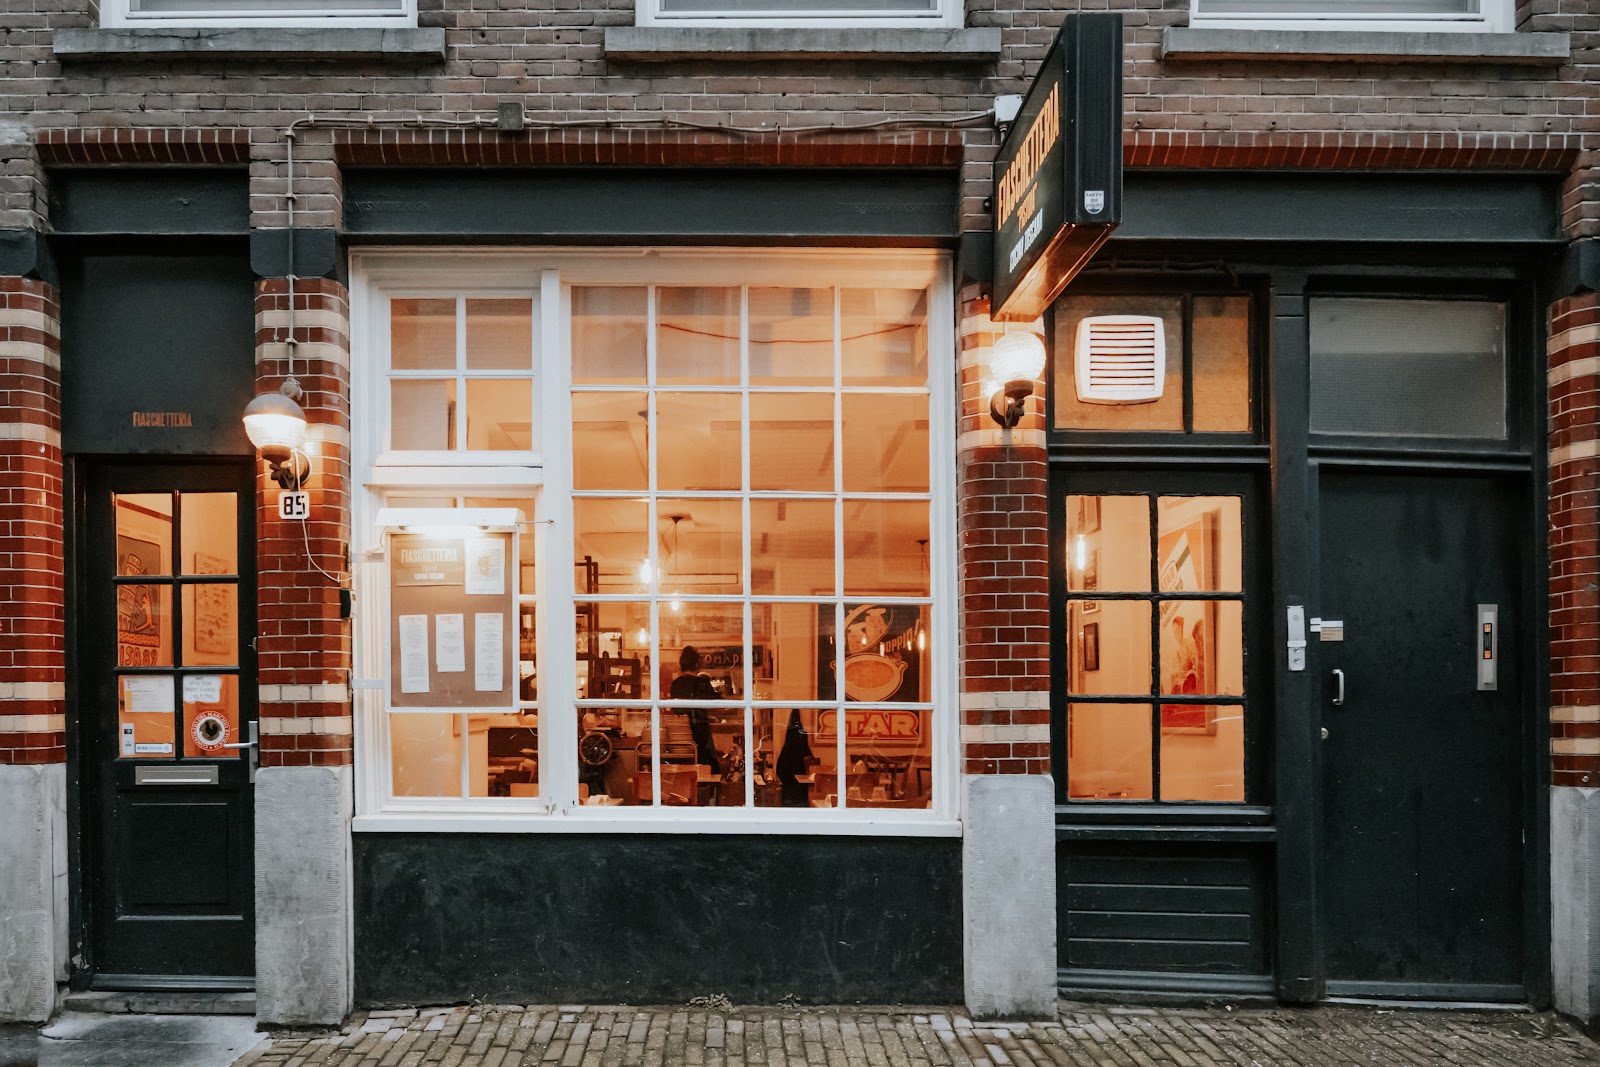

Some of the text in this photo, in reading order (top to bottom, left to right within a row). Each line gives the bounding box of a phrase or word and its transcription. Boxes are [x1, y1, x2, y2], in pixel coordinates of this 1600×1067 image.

[998, 82, 1060, 231] FIASCHETTERIA
[132, 411, 193, 427] FIASCHETTERIA
[401, 548, 458, 563] FIASCHETTERIA
[820, 712, 918, 738] STAR
